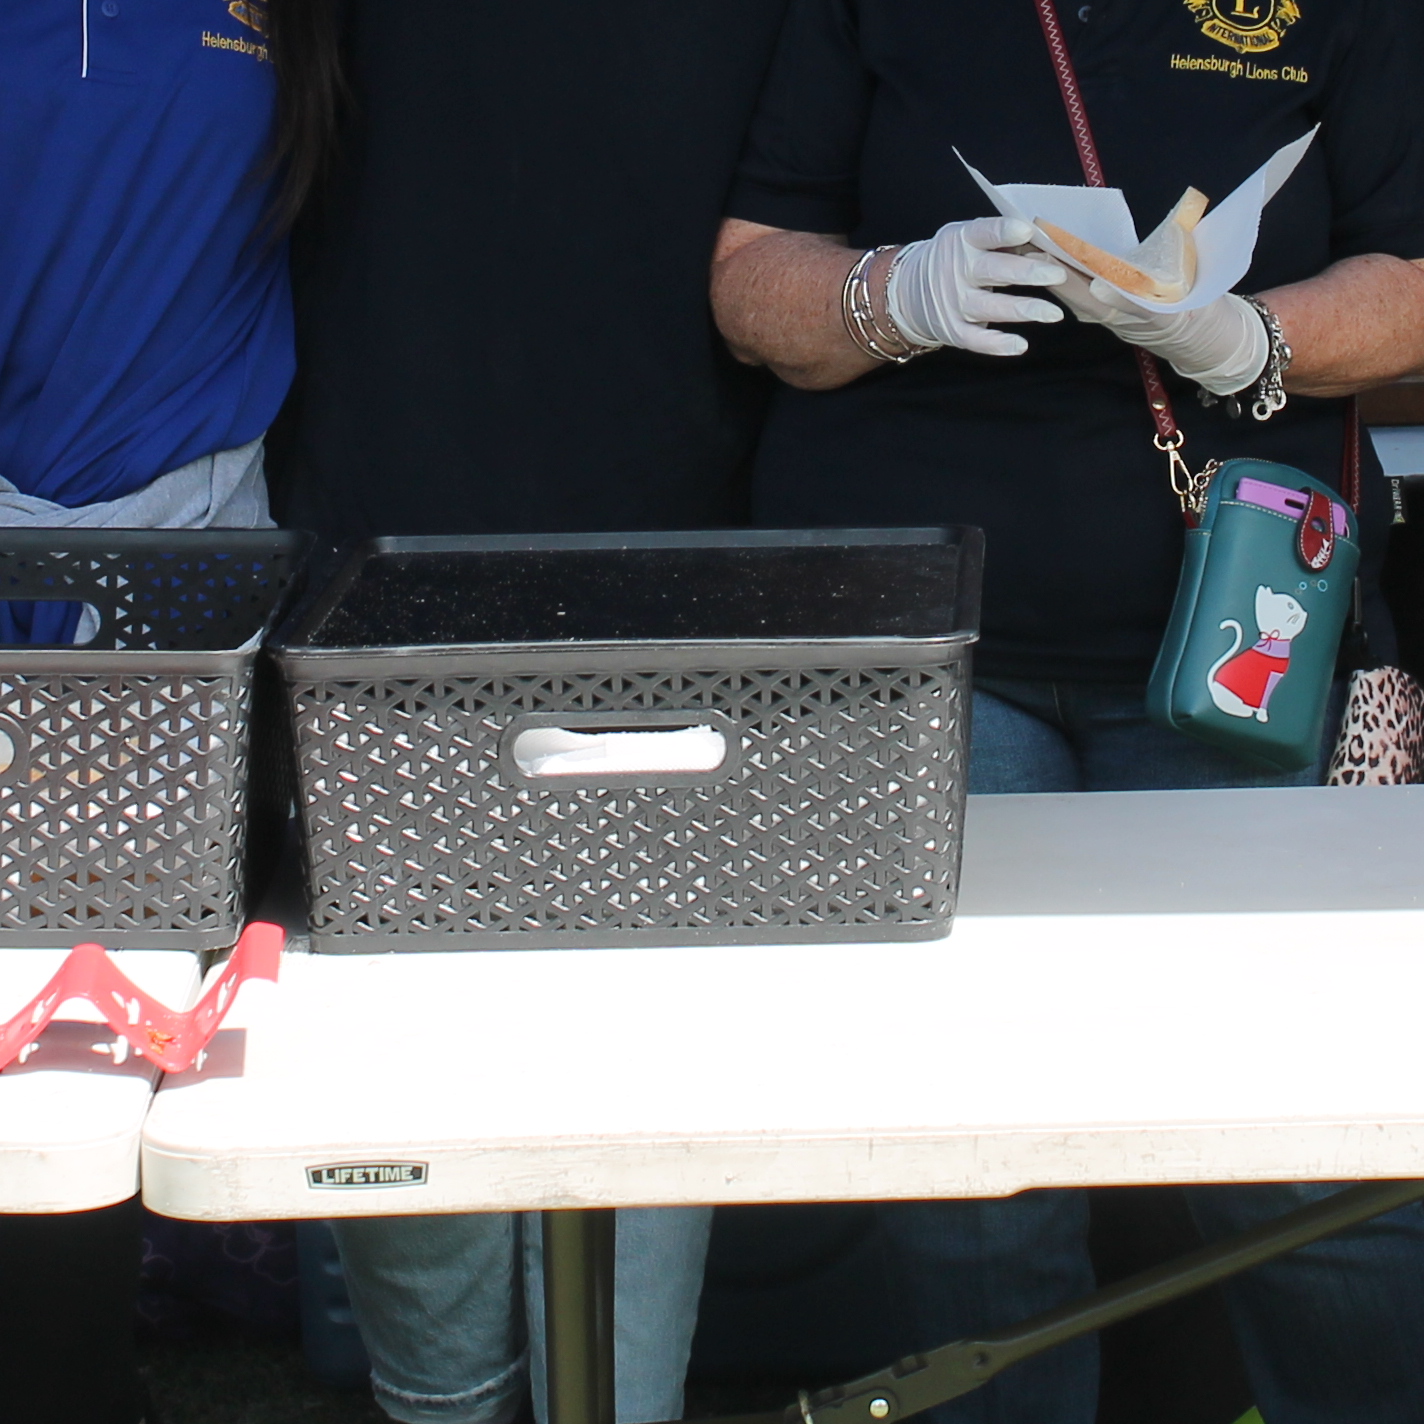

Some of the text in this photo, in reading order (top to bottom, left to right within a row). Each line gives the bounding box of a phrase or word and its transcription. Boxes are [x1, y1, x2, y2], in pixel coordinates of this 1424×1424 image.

[202, 30, 268, 62] Helensburgh
[1170, 53, 1308, 83] Helensburgh Lions Club
[321, 1166, 414, 1184] LIFETIME
